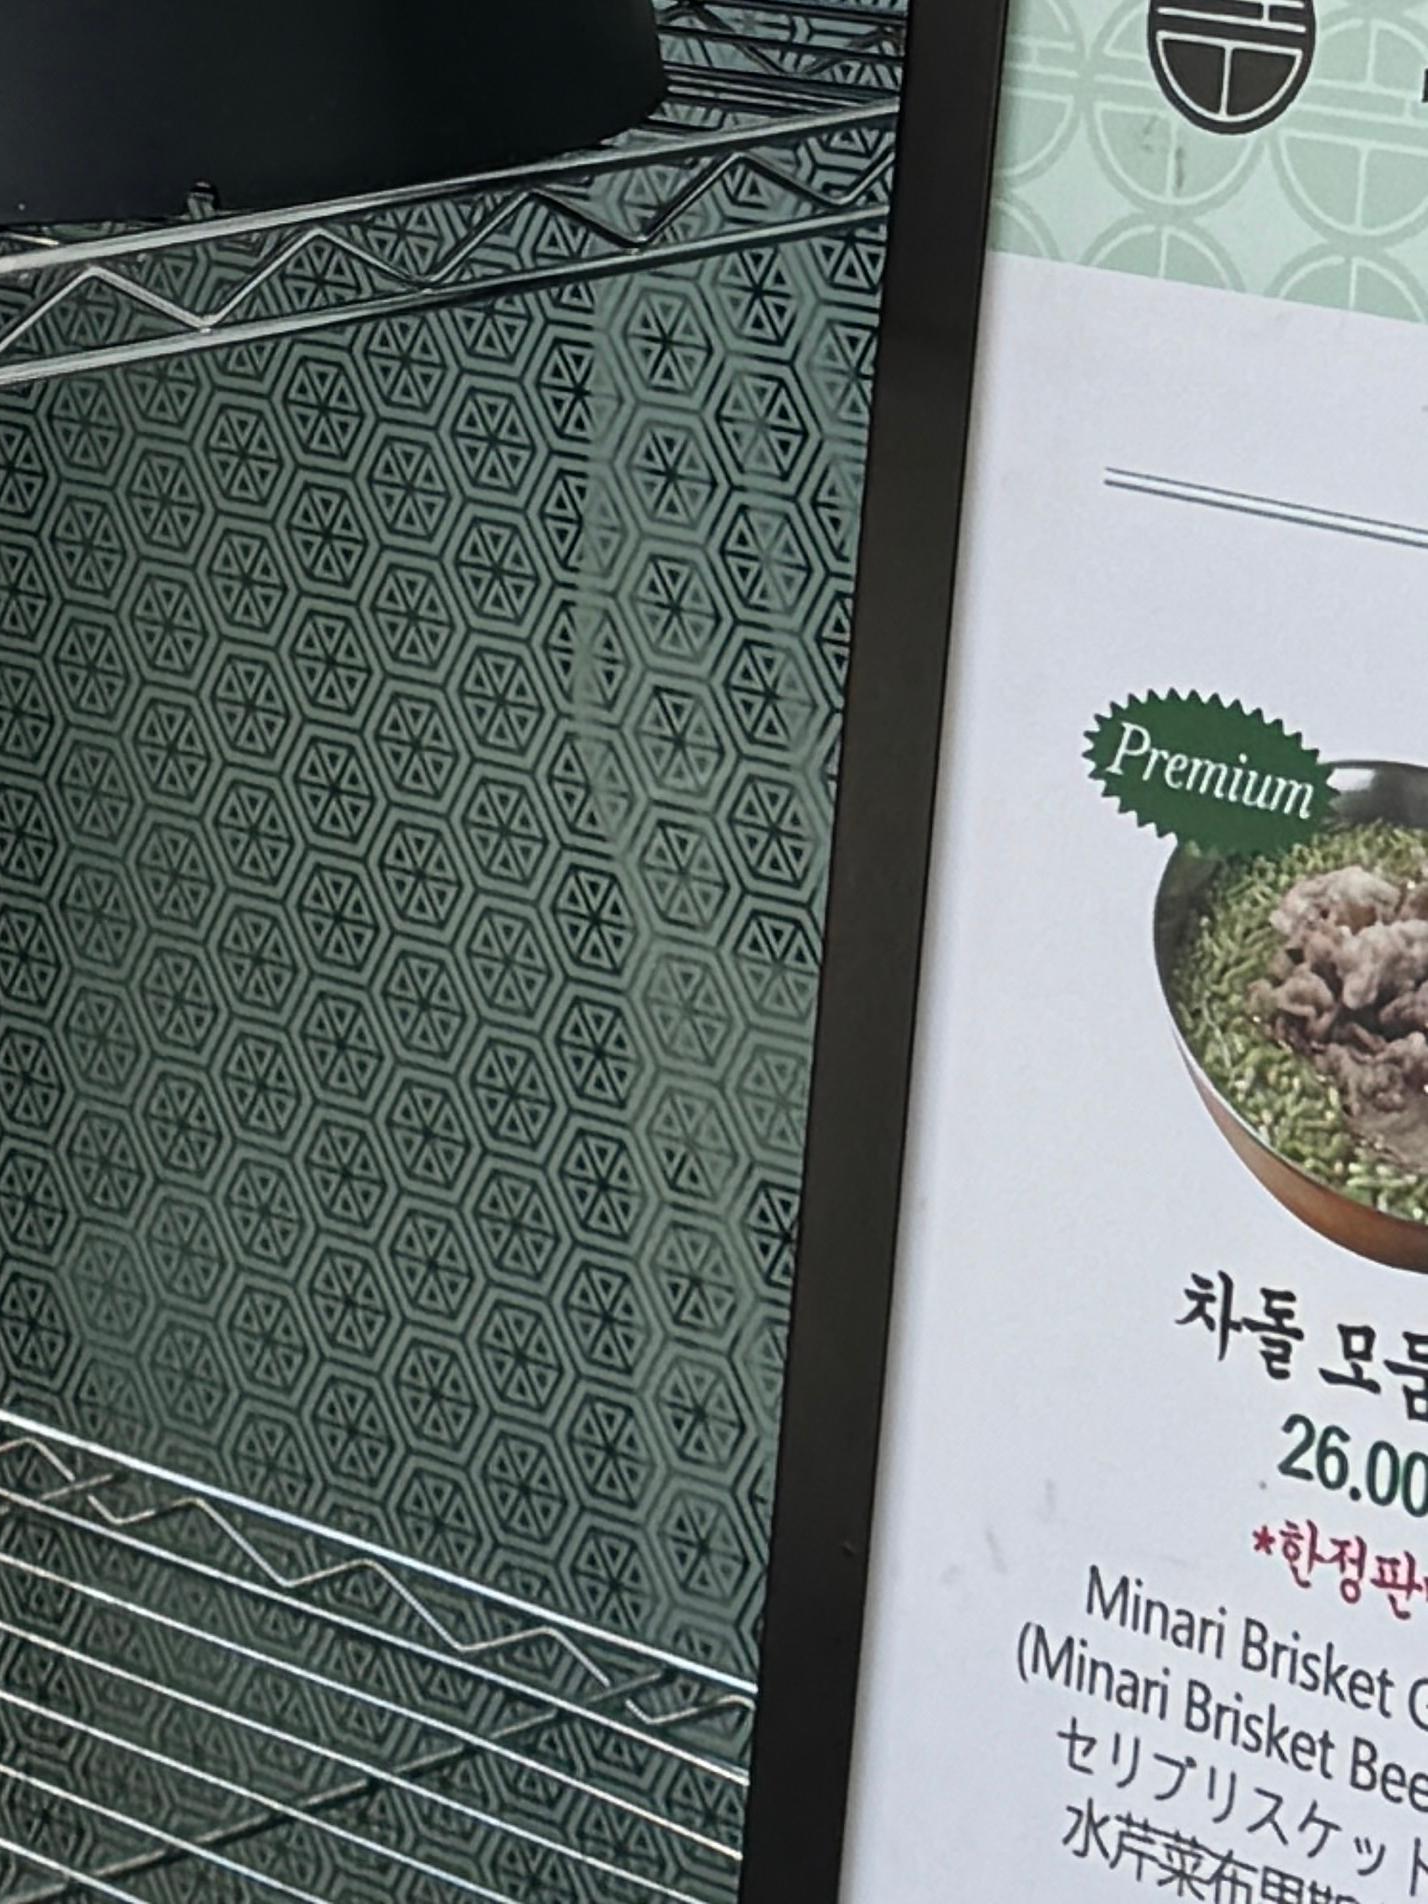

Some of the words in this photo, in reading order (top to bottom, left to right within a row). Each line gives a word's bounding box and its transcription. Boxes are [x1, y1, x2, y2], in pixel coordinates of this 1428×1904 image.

[1105, 720, 1316, 822] Premium
[1174, 1269, 1305, 1381] 차돌
[1252, 1518, 1428, 1621] 한정판
[1085, 1564, 1229, 1661] Minari
[1241, 1616, 1394, 1721] Brisket
[1016, 1620, 1172, 1722] (Minari
[1183, 1677, 1336, 1782] Brisket
